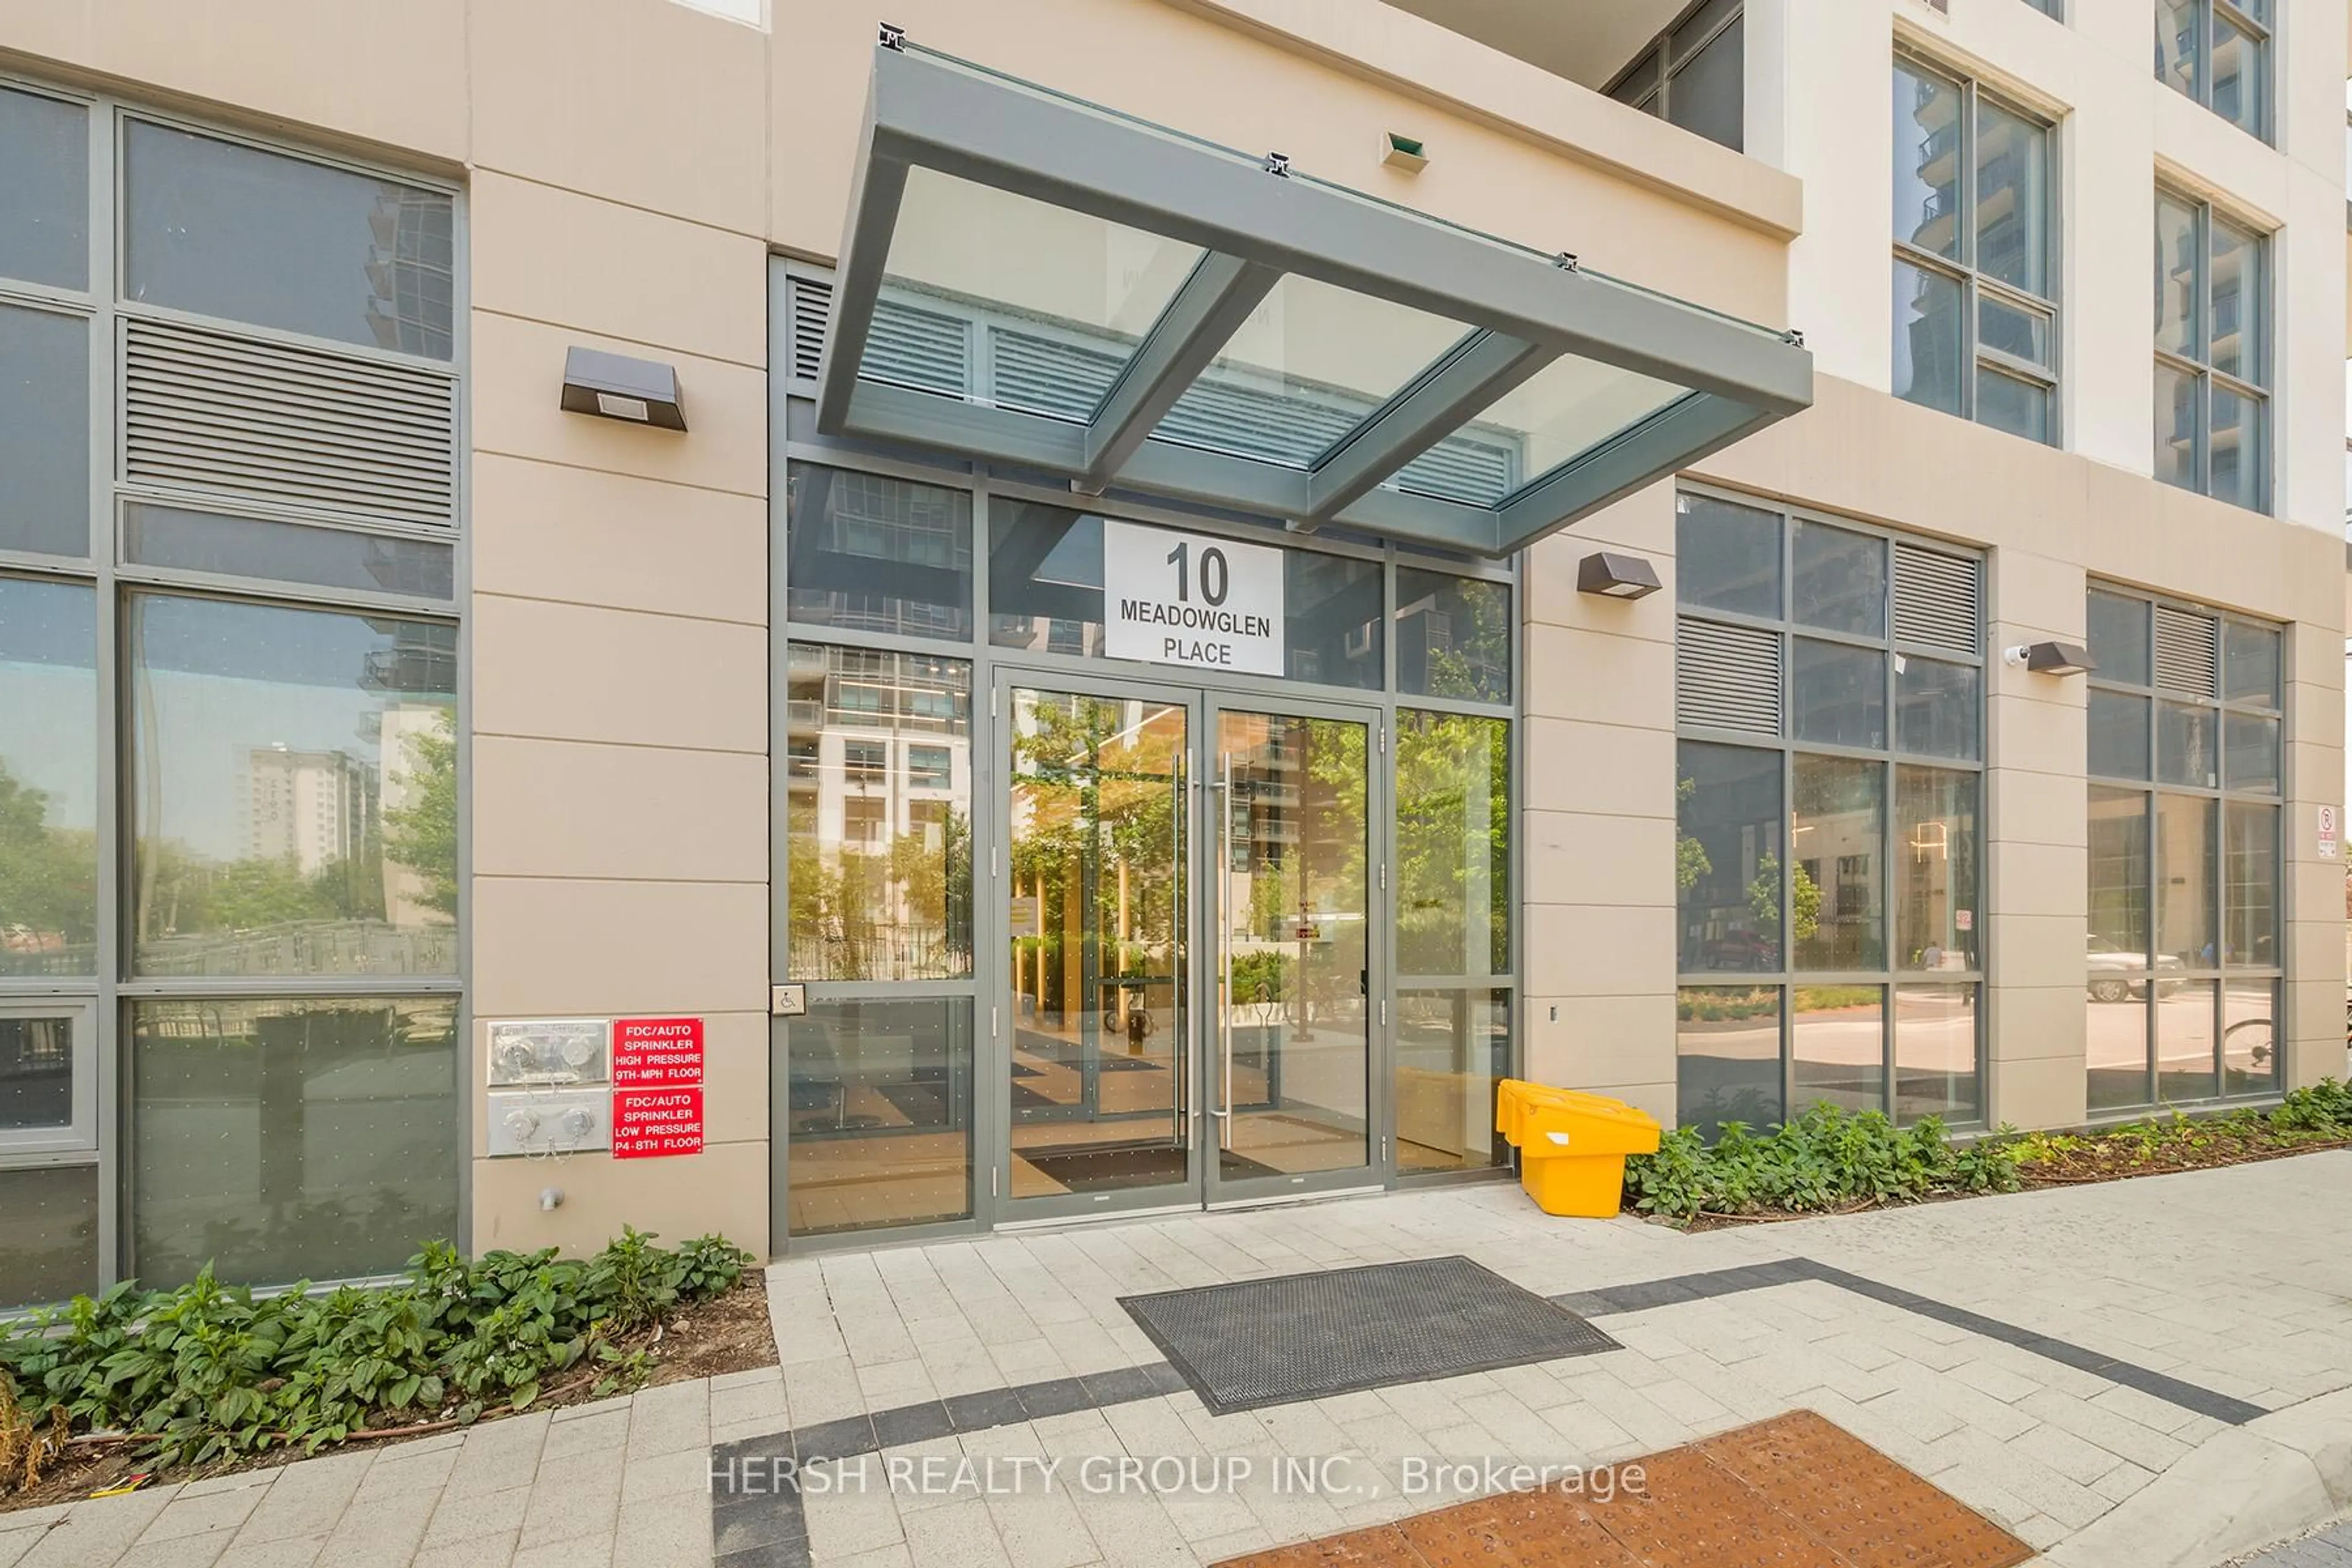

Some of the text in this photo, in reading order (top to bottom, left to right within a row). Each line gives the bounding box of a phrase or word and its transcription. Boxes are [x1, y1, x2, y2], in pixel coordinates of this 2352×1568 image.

[1167, 541, 1229, 607] 10
[1120, 598, 1270, 638] MEADOWGLEN
[1164, 638, 1231, 665] PLACE
[626, 1025, 692, 1036] FDC/AUTO
[624, 1039, 693, 1052] SPRINKLER
[615, 1054, 701, 1066] HIGH PRESSURE
[668, 1068, 701, 1078] FLOOR
[625, 1095, 691, 1107] FDC/AUTO
[624, 1109, 693, 1122] SPRINKLER
[615, 1123, 701, 1137] LOW PRESSURE
[664, 1137, 701, 1148] FLOOR
